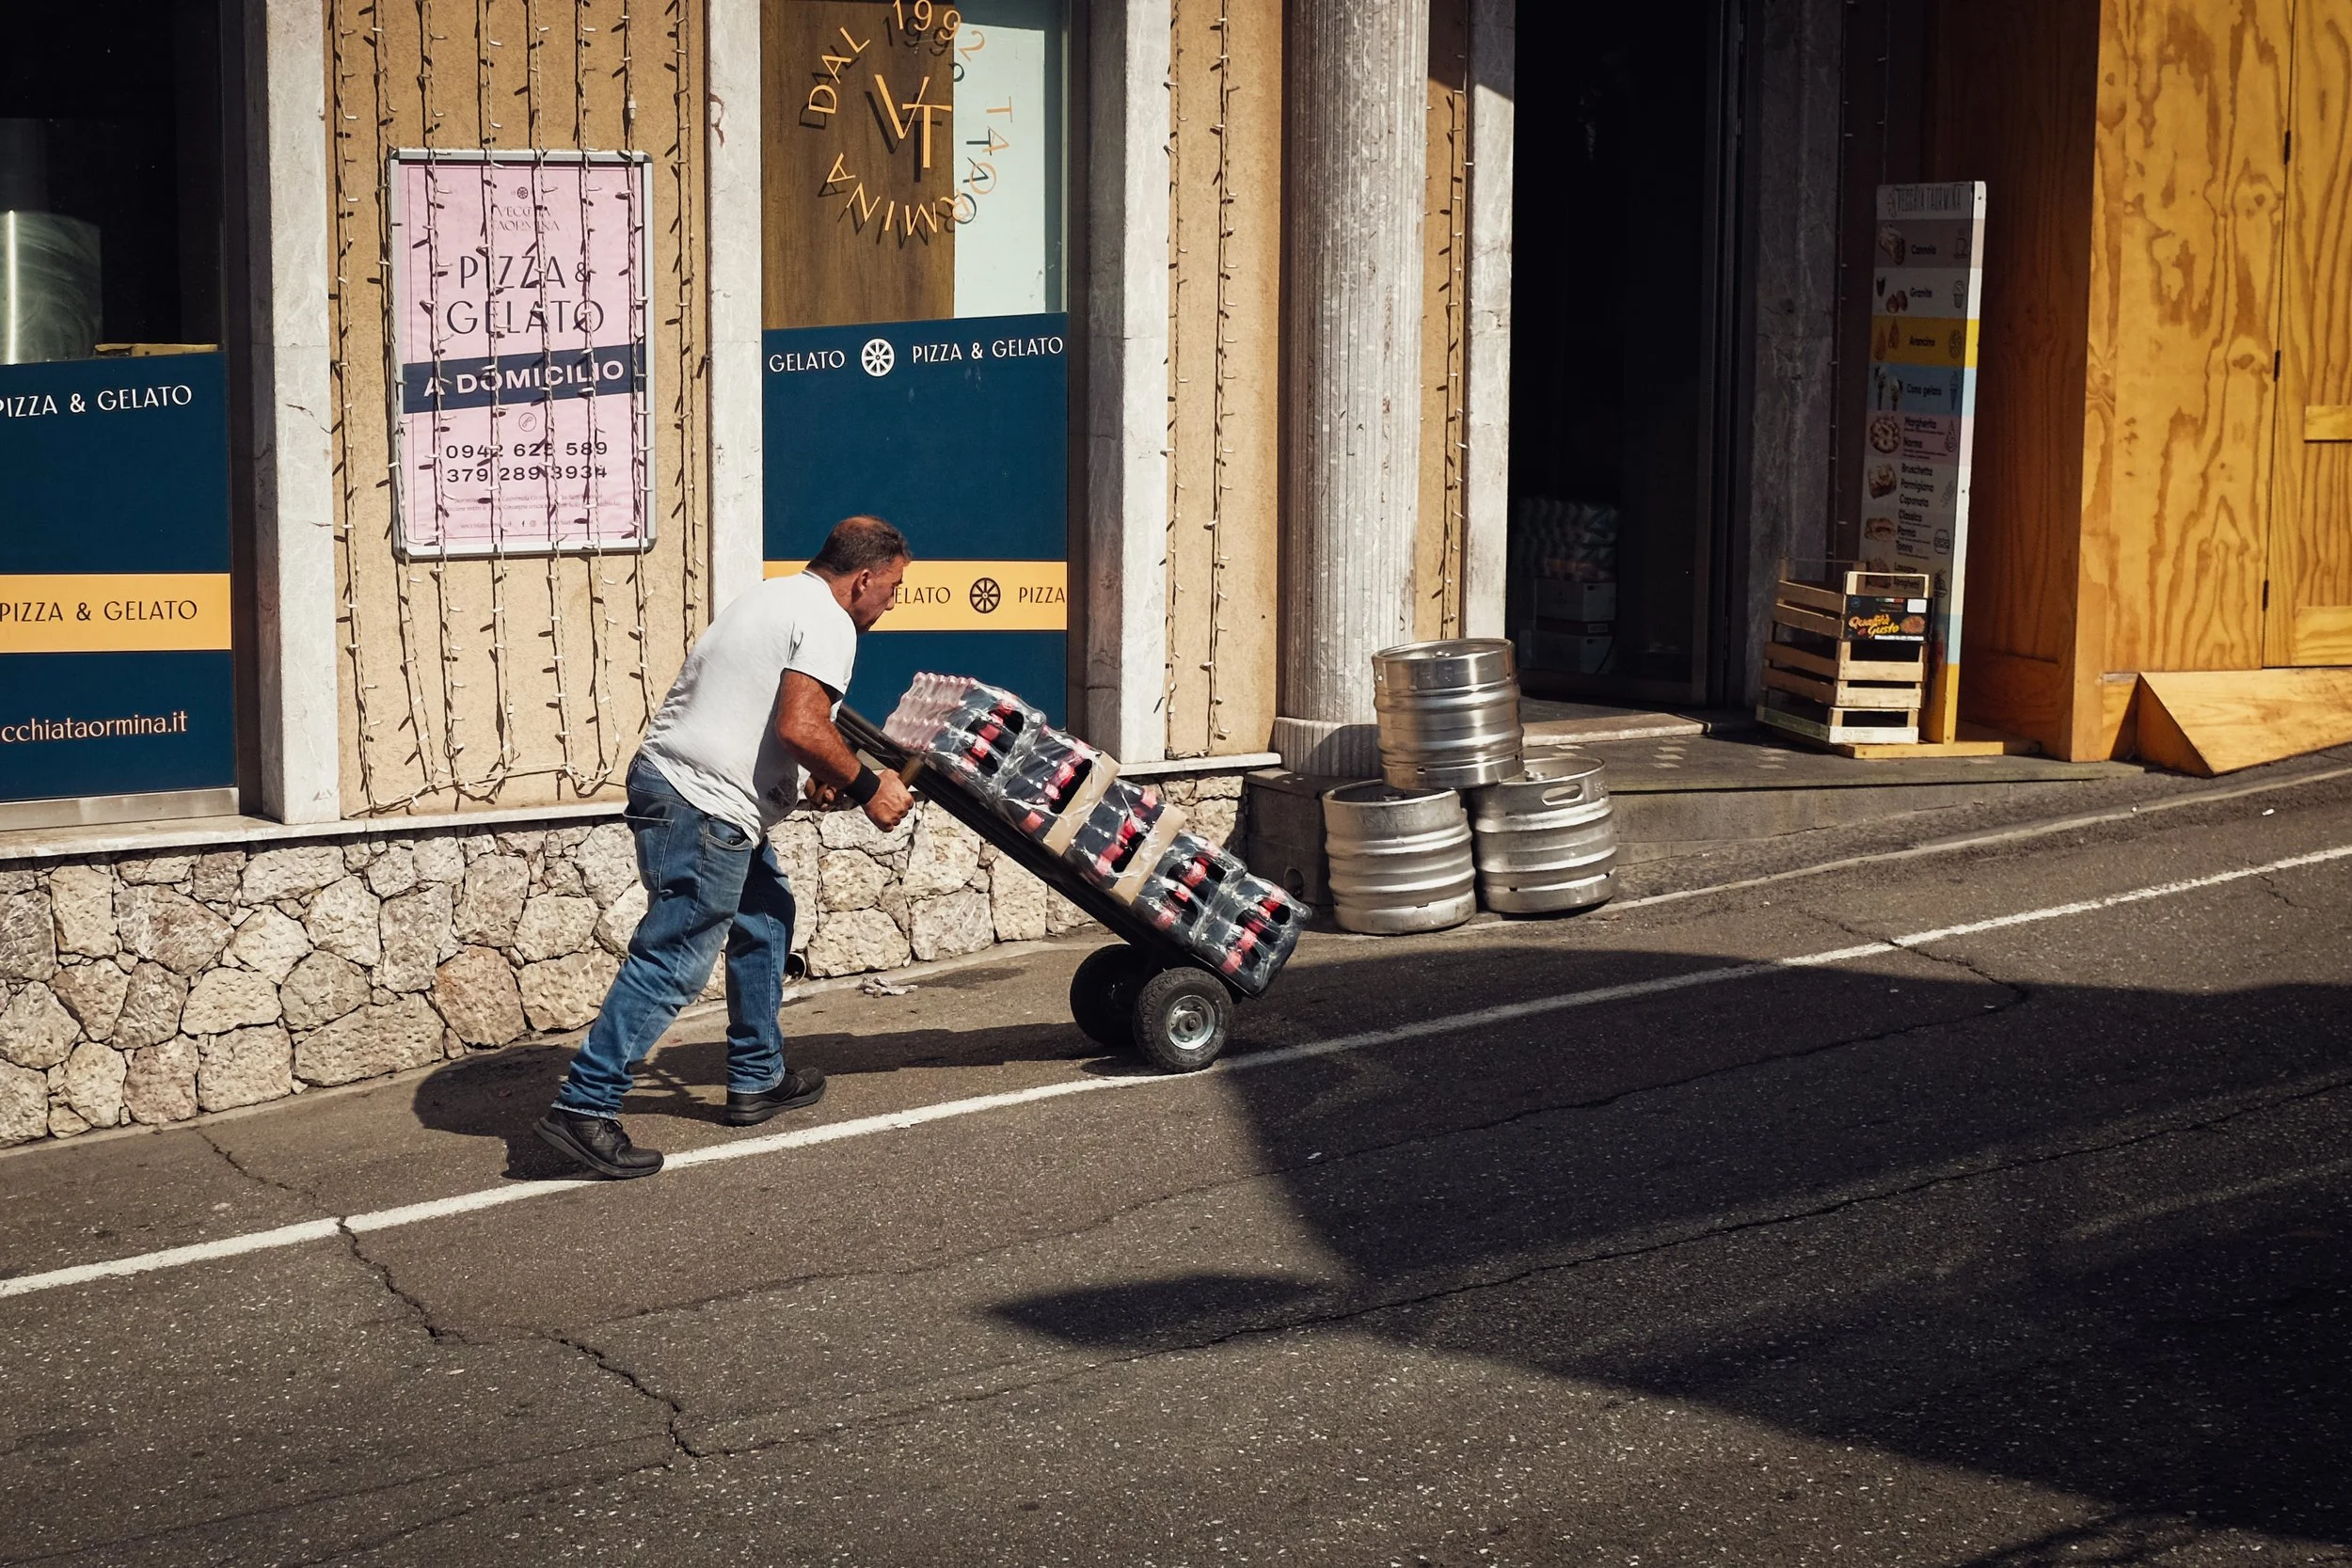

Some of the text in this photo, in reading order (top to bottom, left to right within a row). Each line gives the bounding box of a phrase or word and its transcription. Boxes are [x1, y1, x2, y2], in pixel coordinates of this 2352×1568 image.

[808, 0, 986, 114] DAL 1992
[460, 256, 588, 289] PIZZA &
[447, 300, 605, 334] GELATO
[769, 337, 1064, 372] GELATO PIZZA & GELATO
[423, 360, 624, 397] A DOMICILIO
[0, 385, 192, 418] IZZA & GELATO
[446, 445, 503, 459] 0942
[566, 442, 608, 455] 589
[447, 468, 488, 483] 379
[500, 467, 540, 481] 289
[0, 600, 198, 622] PIZZA & GELATO
[894, 587, 1066, 604] ELATO PIZZA
[1, 710, 188, 743] cchiataormina.it
